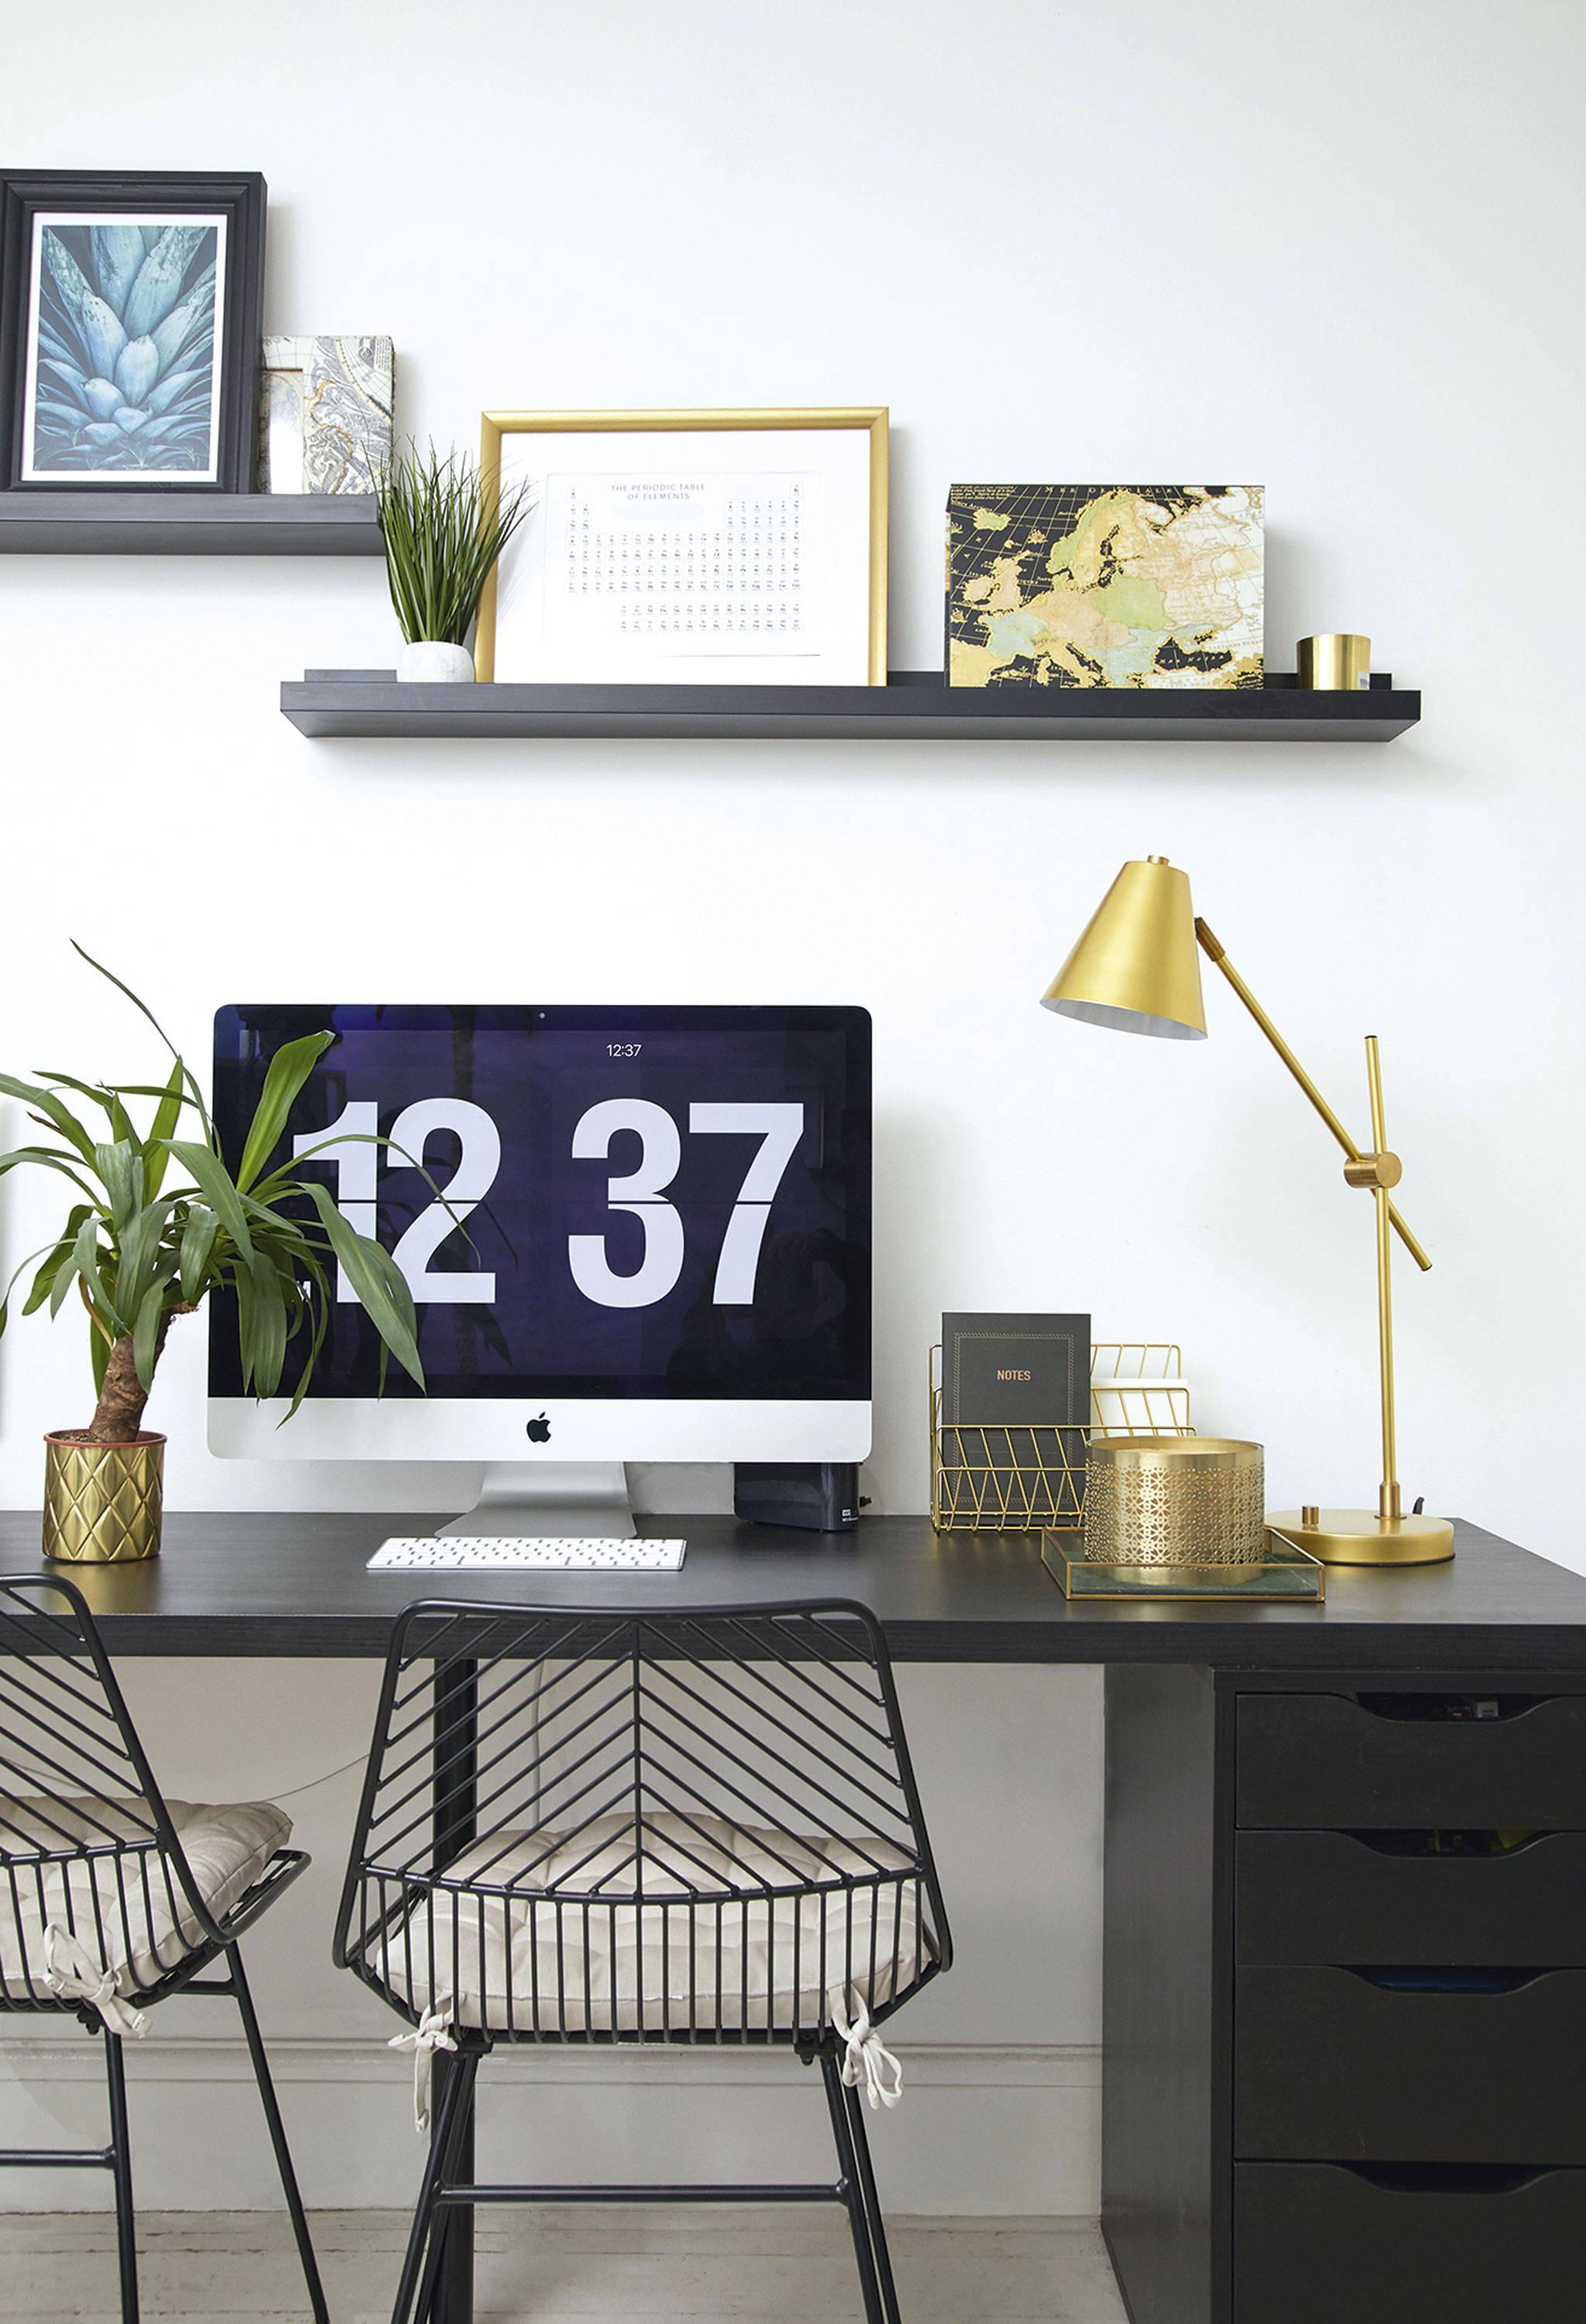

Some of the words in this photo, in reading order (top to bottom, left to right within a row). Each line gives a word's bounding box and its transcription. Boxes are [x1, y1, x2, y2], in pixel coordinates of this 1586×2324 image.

[643, 492, 690, 500] ELEMENTS
[607, 1043, 642, 1057] 12:37
[293, 1097, 501, 1303] 12
[568, 1098, 804, 1308] 37
[997, 1370, 1031, 1381] NOTES
